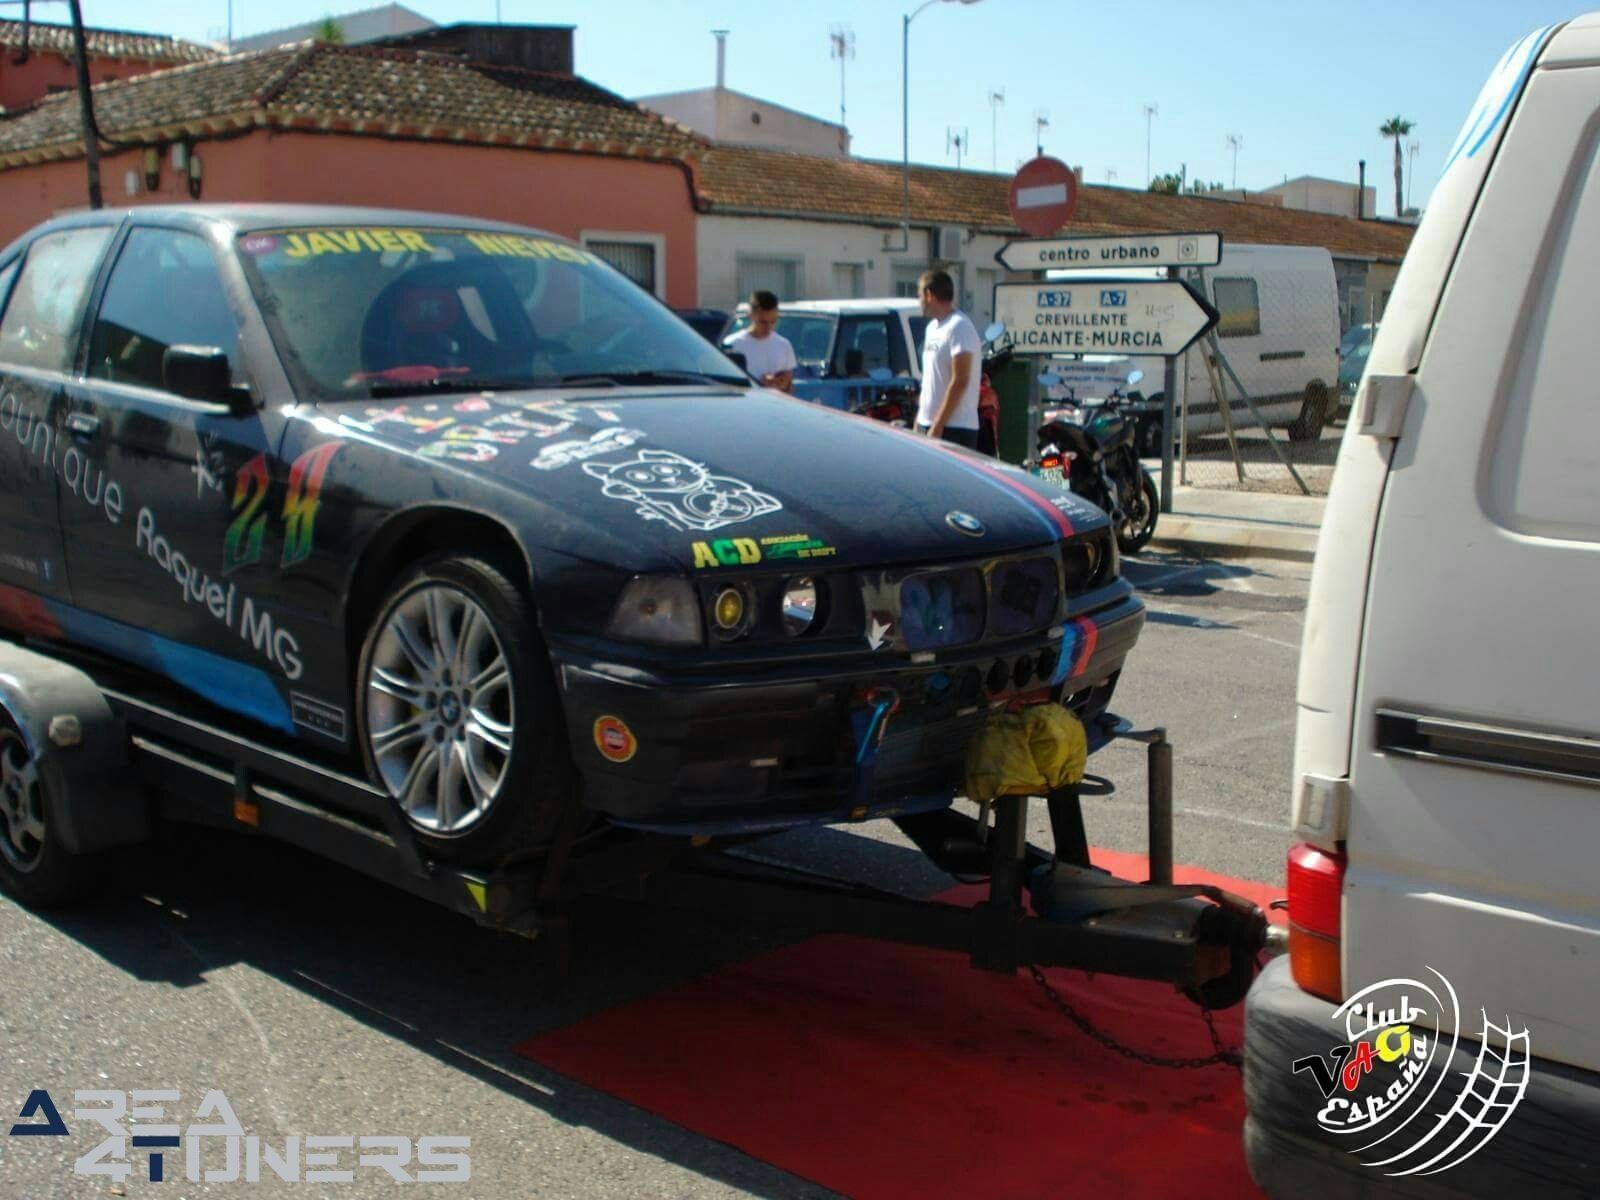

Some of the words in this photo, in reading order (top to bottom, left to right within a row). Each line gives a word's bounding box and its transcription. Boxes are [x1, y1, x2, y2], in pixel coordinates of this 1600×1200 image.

[286, 229, 436, 259] JAVIER
[1039, 246, 1090, 263] centro
[1101, 244, 1160, 260] urbano
[1035, 313, 1128, 327] CREVILLENTE
[691, 537, 762, 569] ACD
[136, 507, 235, 627] Raquel
[240, 598, 303, 680] MG
